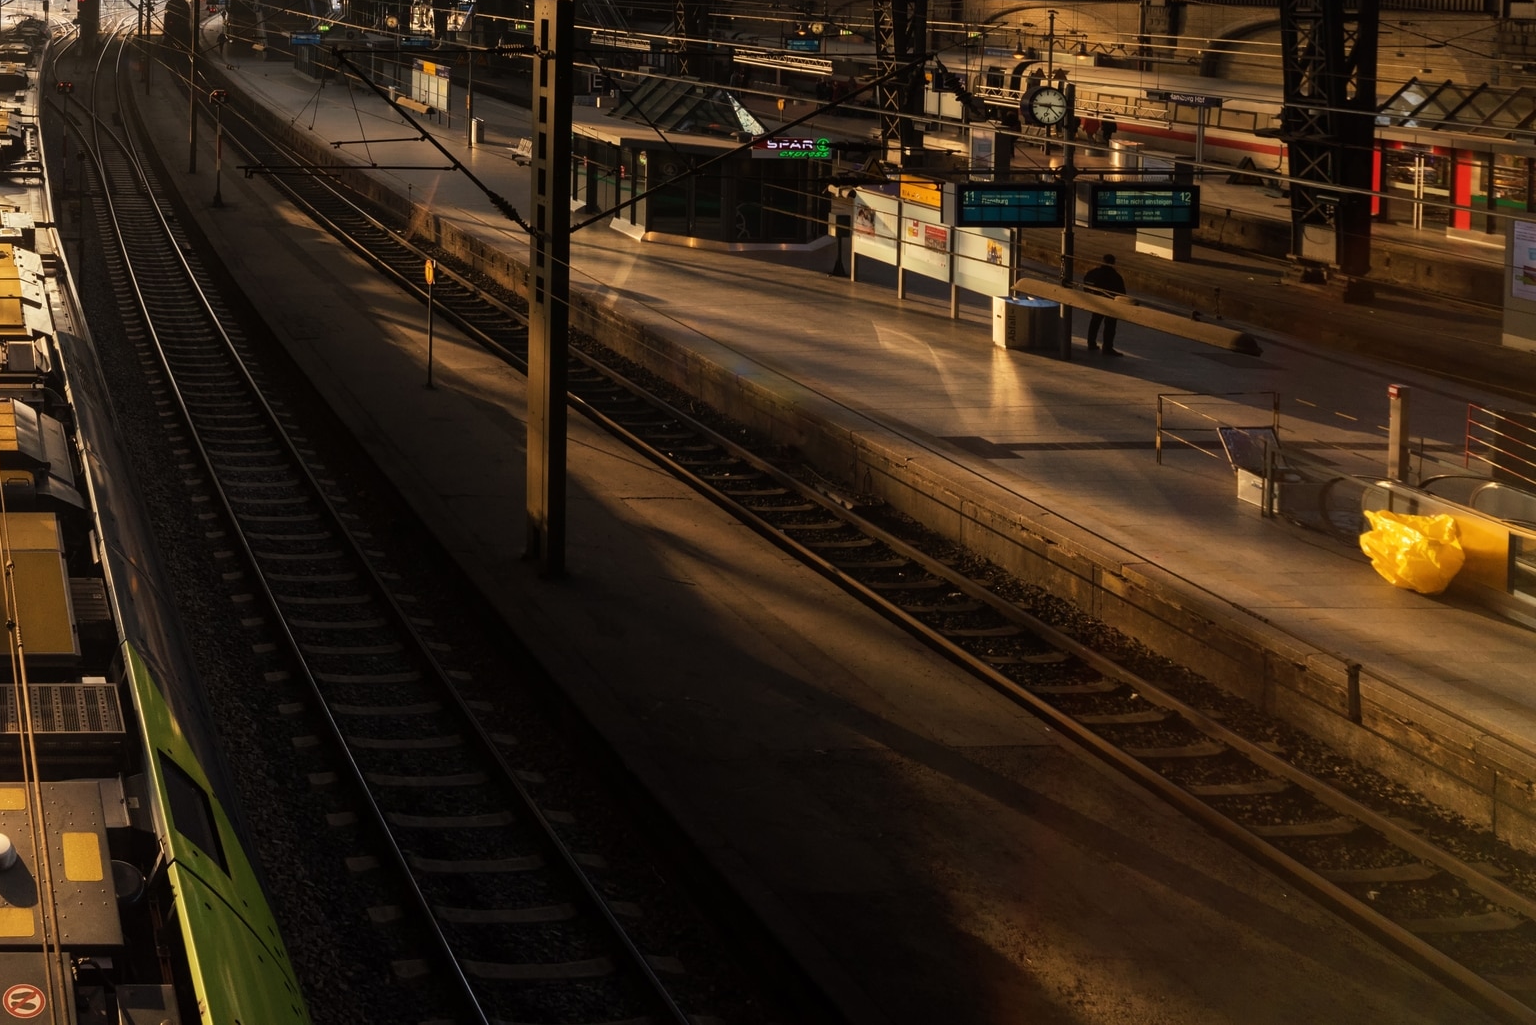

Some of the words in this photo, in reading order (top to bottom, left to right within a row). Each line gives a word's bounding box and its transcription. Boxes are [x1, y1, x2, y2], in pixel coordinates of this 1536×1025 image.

[593, 73, 603, 88] E
[767, 139, 813, 149] SPAR
[964, 191, 975, 202] 11
[1179, 192, 1191, 202] 12
[1008, 315, 1016, 342] Abfall
